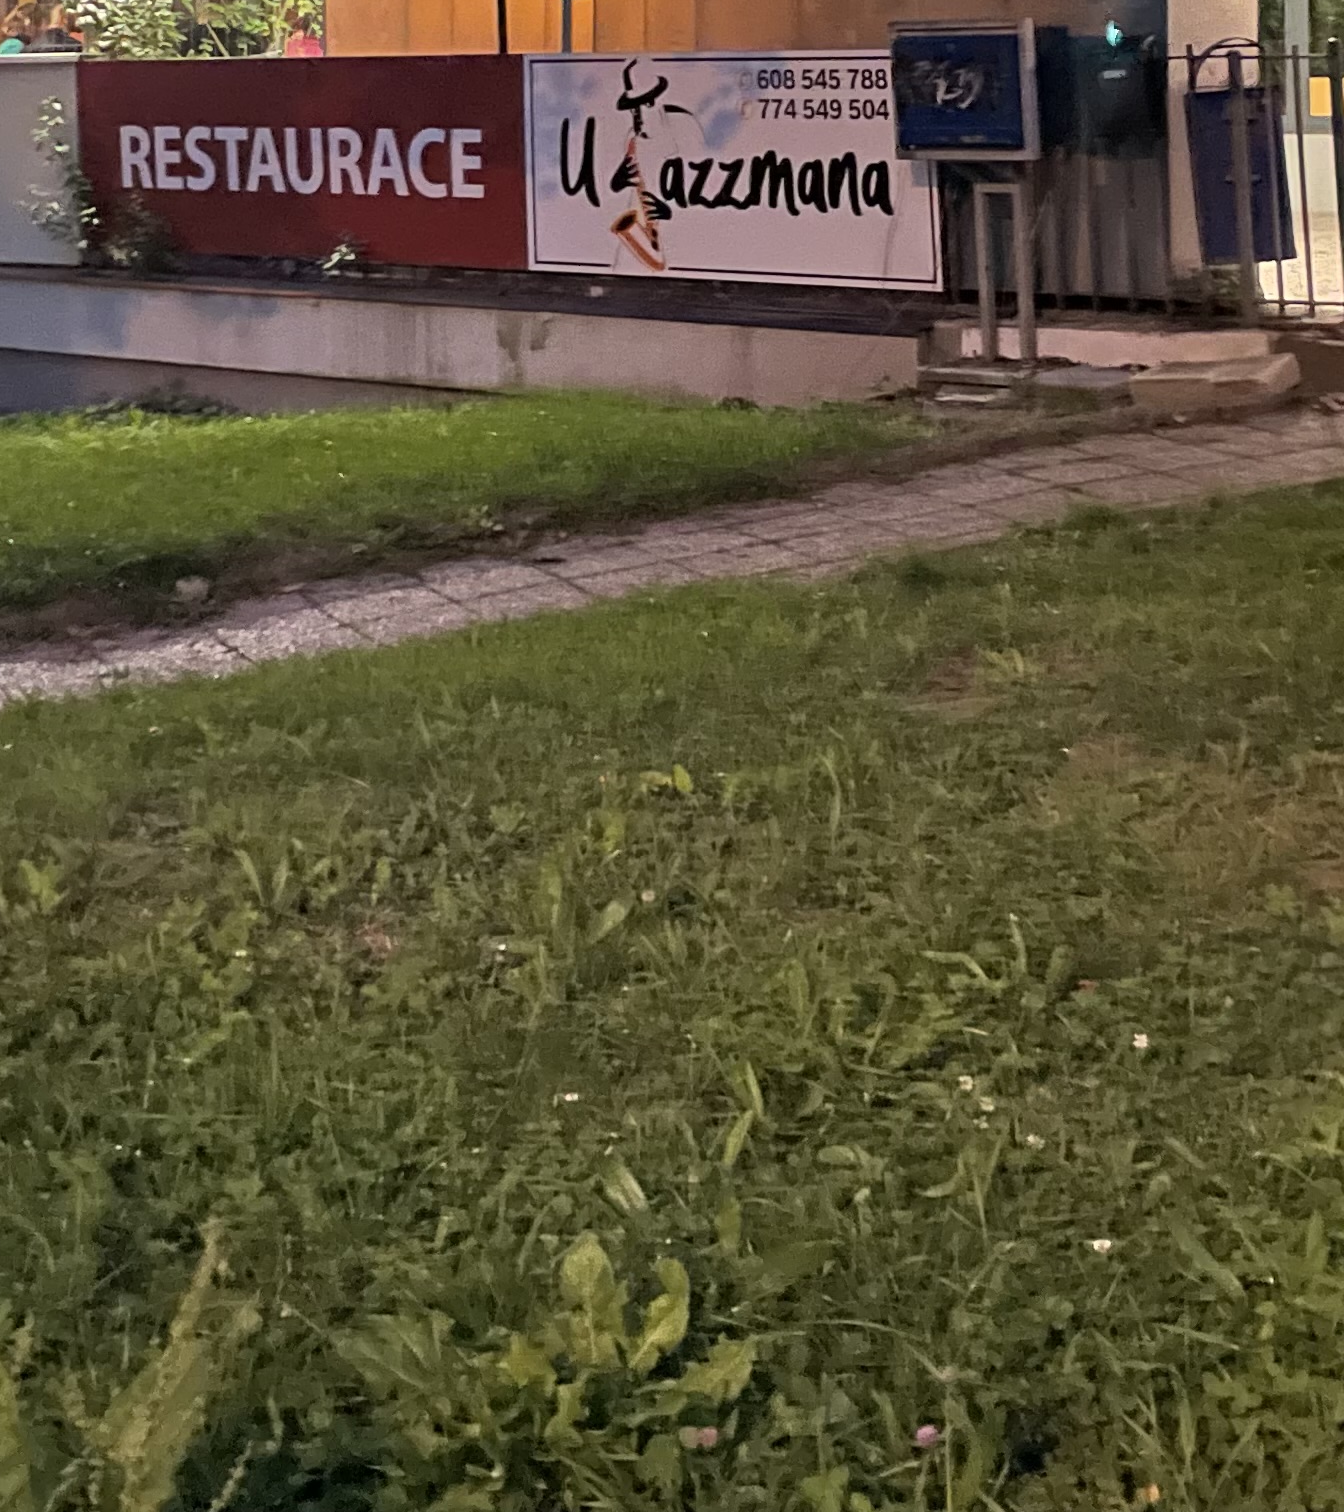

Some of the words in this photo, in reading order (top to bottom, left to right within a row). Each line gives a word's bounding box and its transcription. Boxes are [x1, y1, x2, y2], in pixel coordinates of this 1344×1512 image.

[757, 69, 796, 90] 608
[801, 69, 841, 90] 545
[846, 69, 889, 90] 788
[758, 98, 797, 120] 774
[802, 98, 843, 120] 549
[848, 98, 890, 120] 504
[119, 125, 485, 199] RESTAURACE
[560, 116, 601, 208] U
